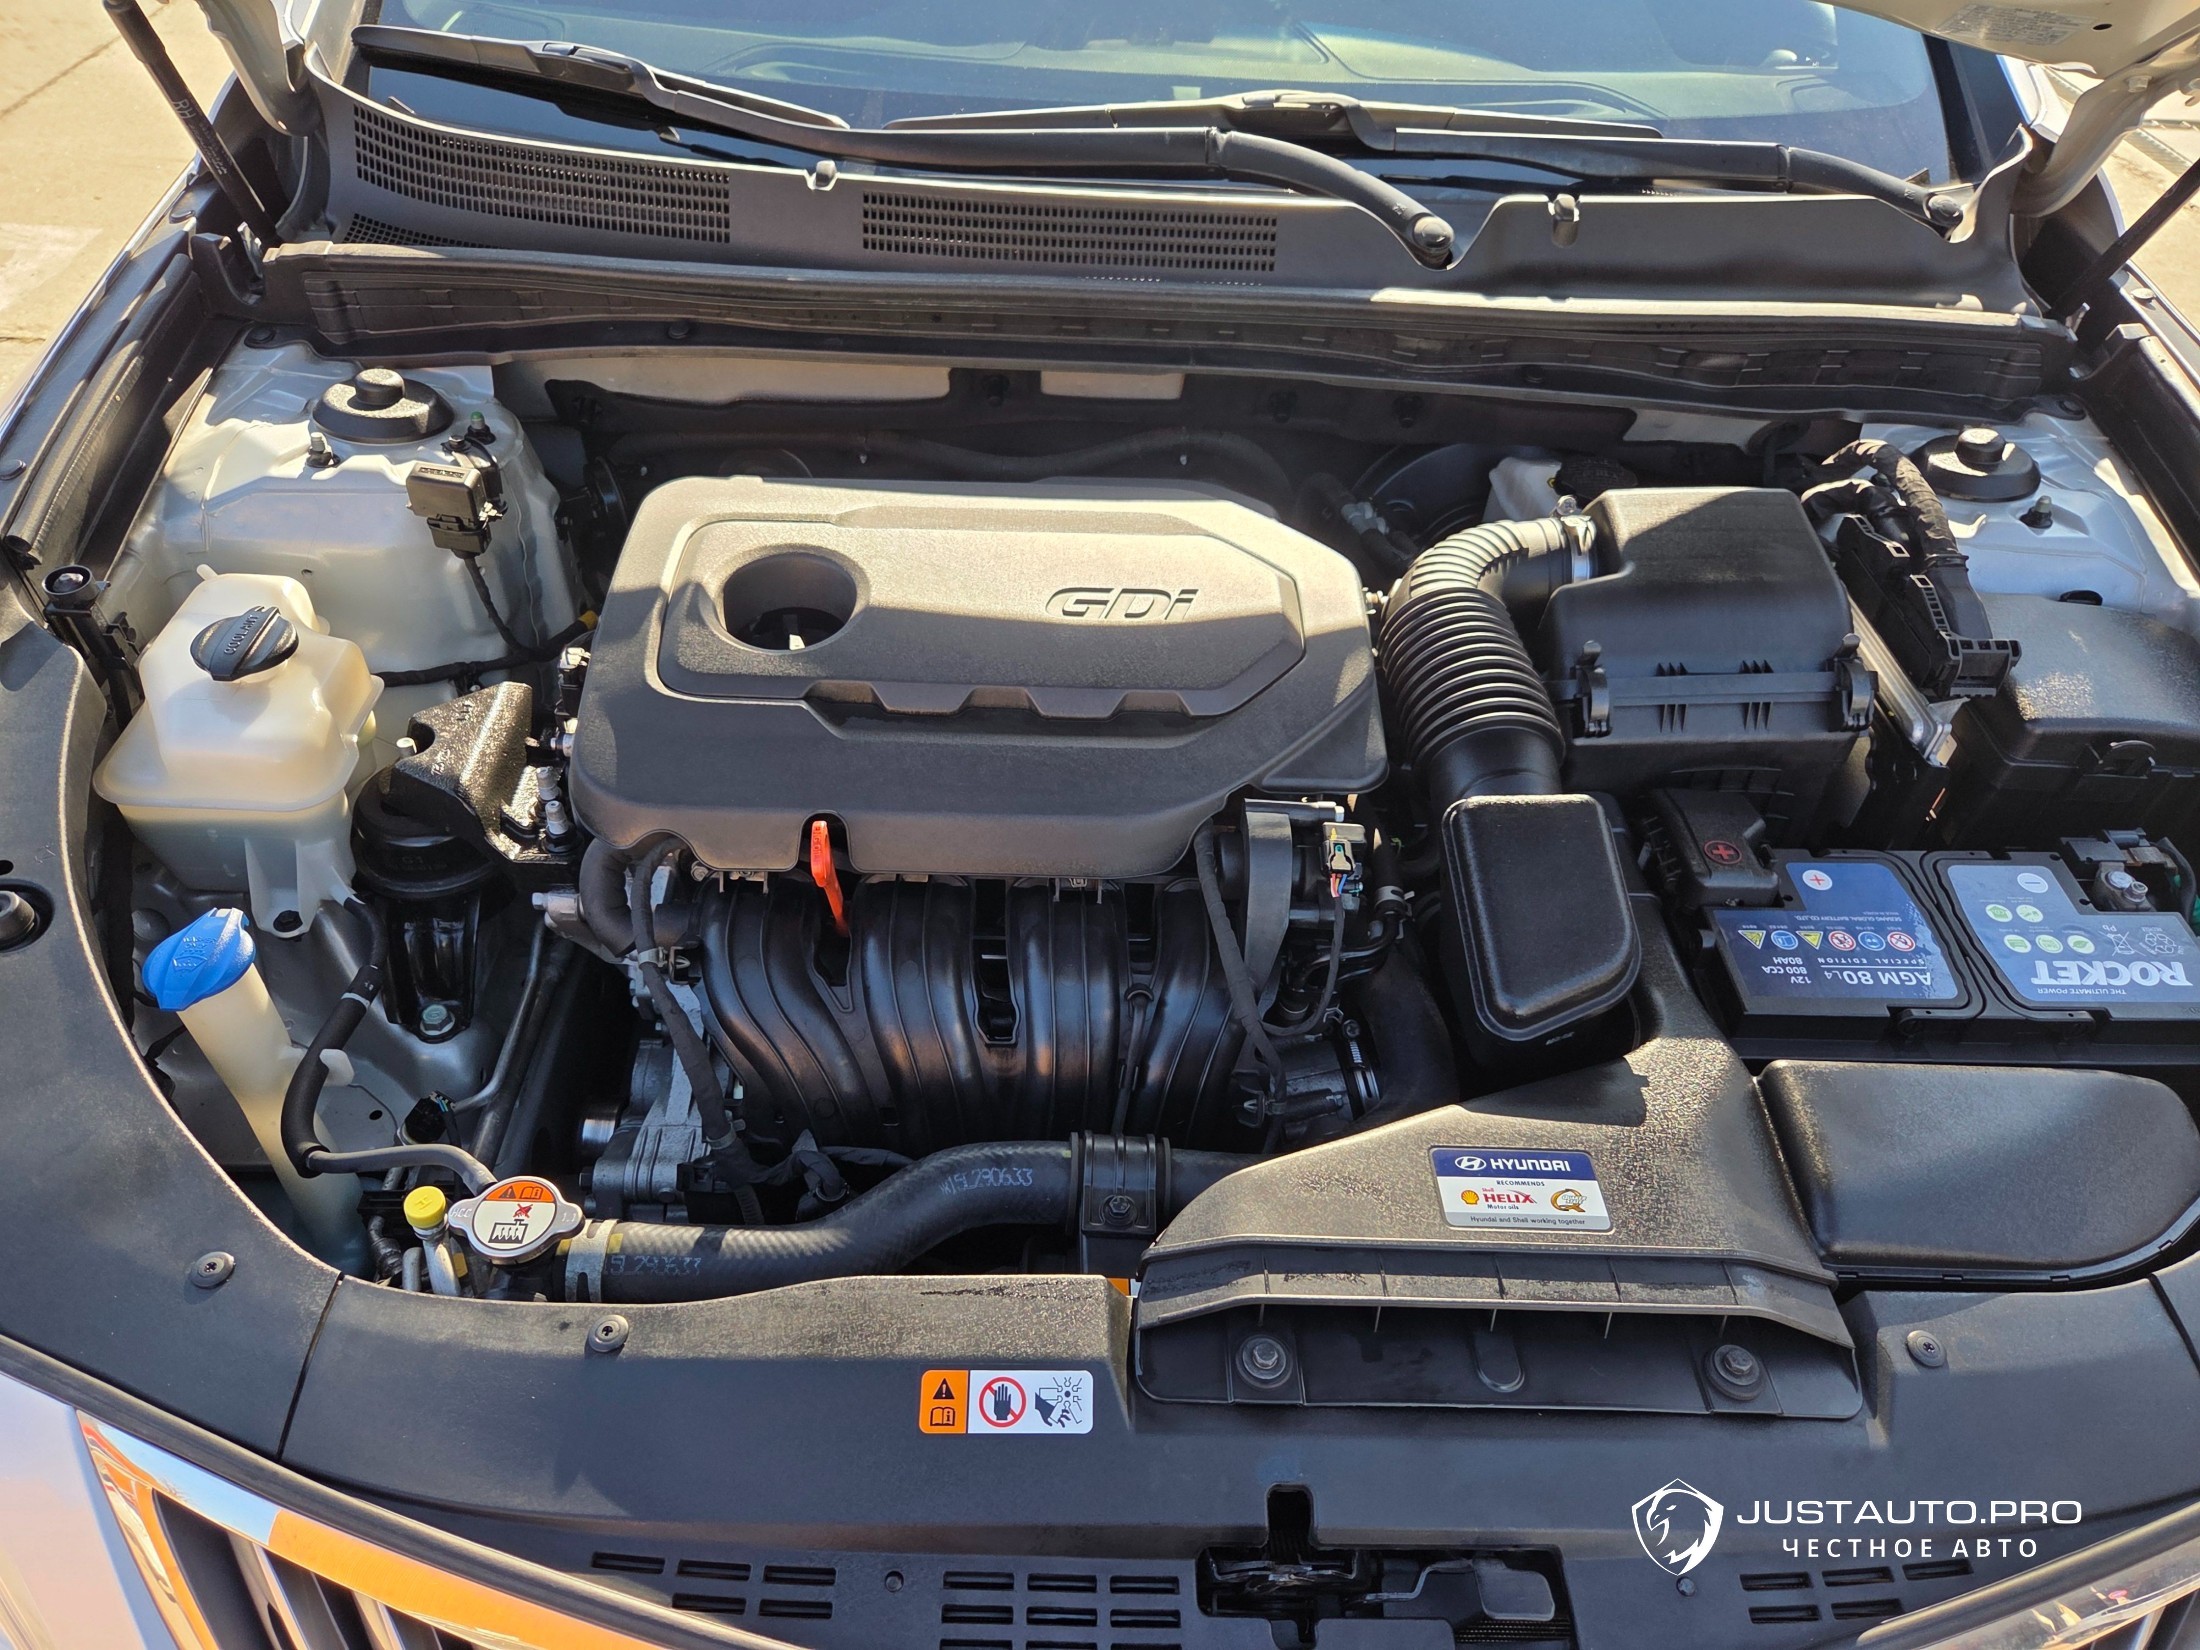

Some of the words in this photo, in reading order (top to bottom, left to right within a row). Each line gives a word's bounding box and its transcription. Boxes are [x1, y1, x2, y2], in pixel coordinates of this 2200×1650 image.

[171, 98, 197, 119] RH
[1045, 587, 1199, 620] GDi
[224, 614, 259, 656] COOLANT
[2102, 924, 2117, 932] Pb
[1773, 957, 1803, 965] 80AH
[1875, 957, 1925, 965] SPECIAL
[1761, 966, 1784, 974] CCA
[1785, 966, 1807, 975] 800
[2031, 960, 2193, 986] ROCKET
[1790, 976, 1812, 984] 12V
[1878, 971, 1931, 986] AGM
[1490, 1158, 1571, 1172] HYUNDAI
[1483, 1193, 1536, 1204] HELIX
[450, 1207, 473, 1218] HCC
[561, 1212, 577, 1222] 1.1
[1531, 1217, 1557, 1225] working
[1558, 1218, 1585, 1226] together
